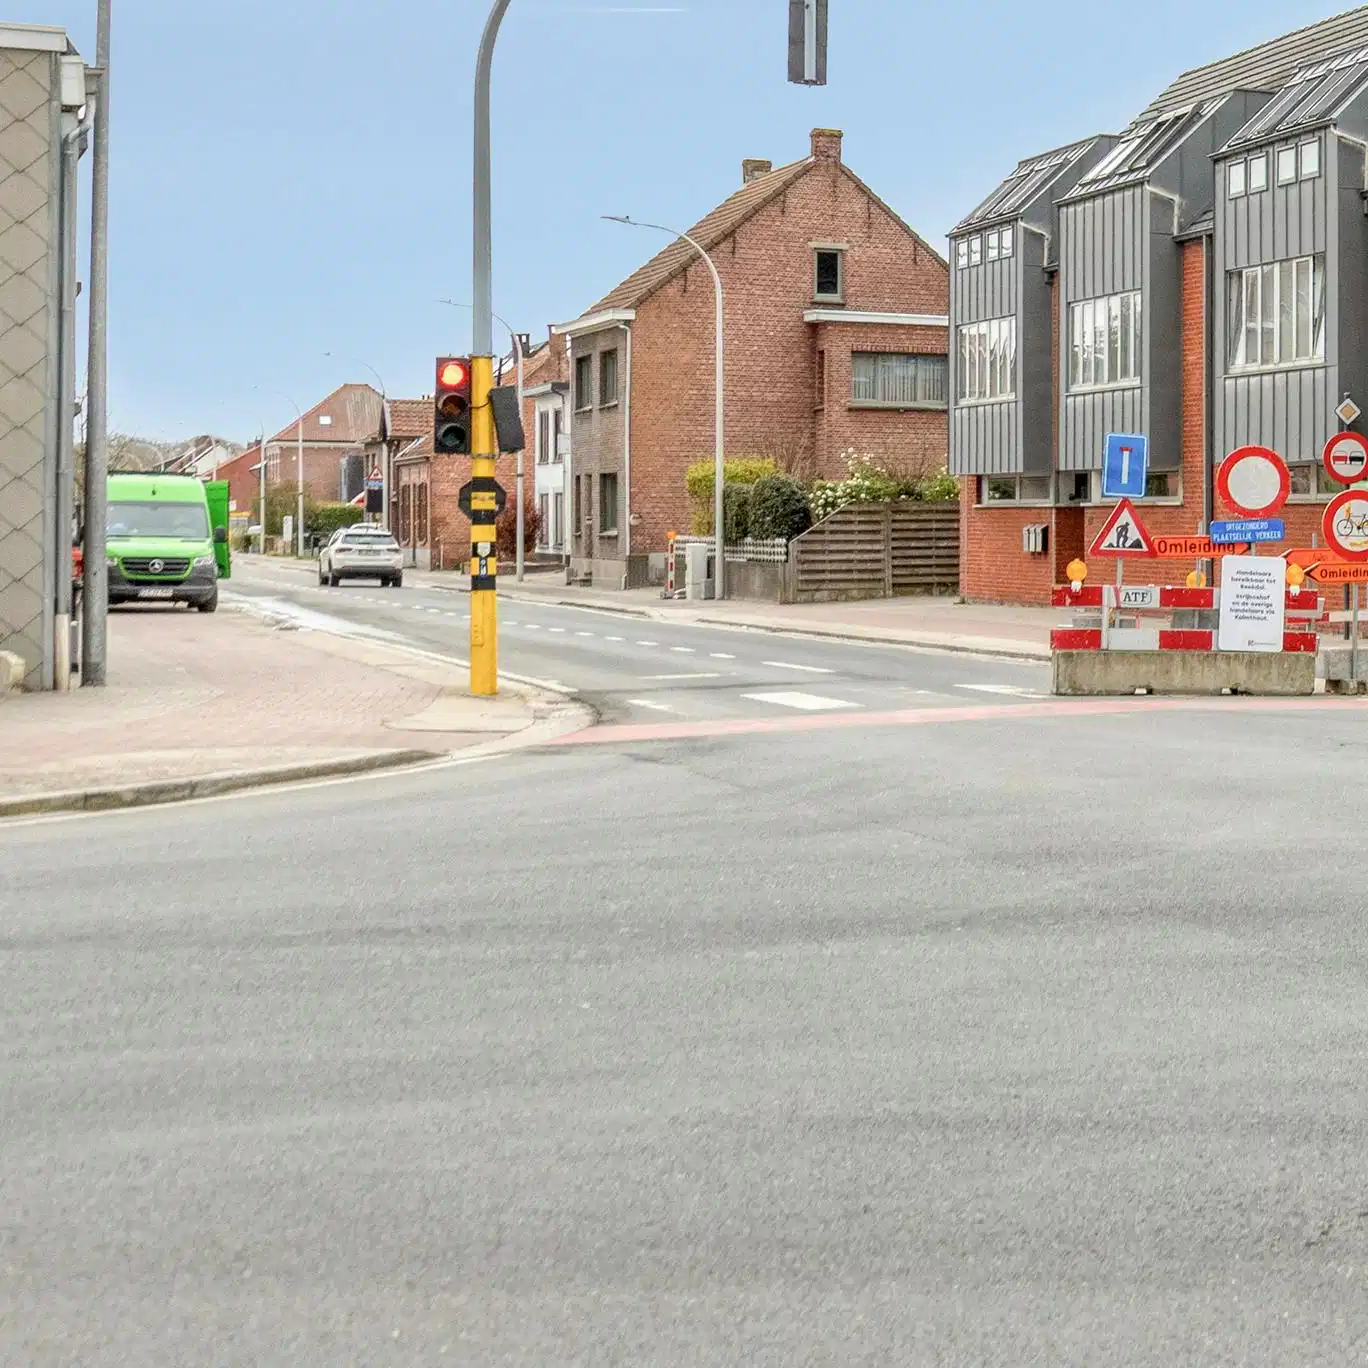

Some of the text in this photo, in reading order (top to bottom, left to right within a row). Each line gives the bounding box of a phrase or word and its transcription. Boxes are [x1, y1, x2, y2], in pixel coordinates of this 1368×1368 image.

[1213, 531, 1281, 542] PLAATSELIJK VERKEER
[1157, 539, 1235, 554] Omleiding
[1123, 592, 1148, 602] ATF
